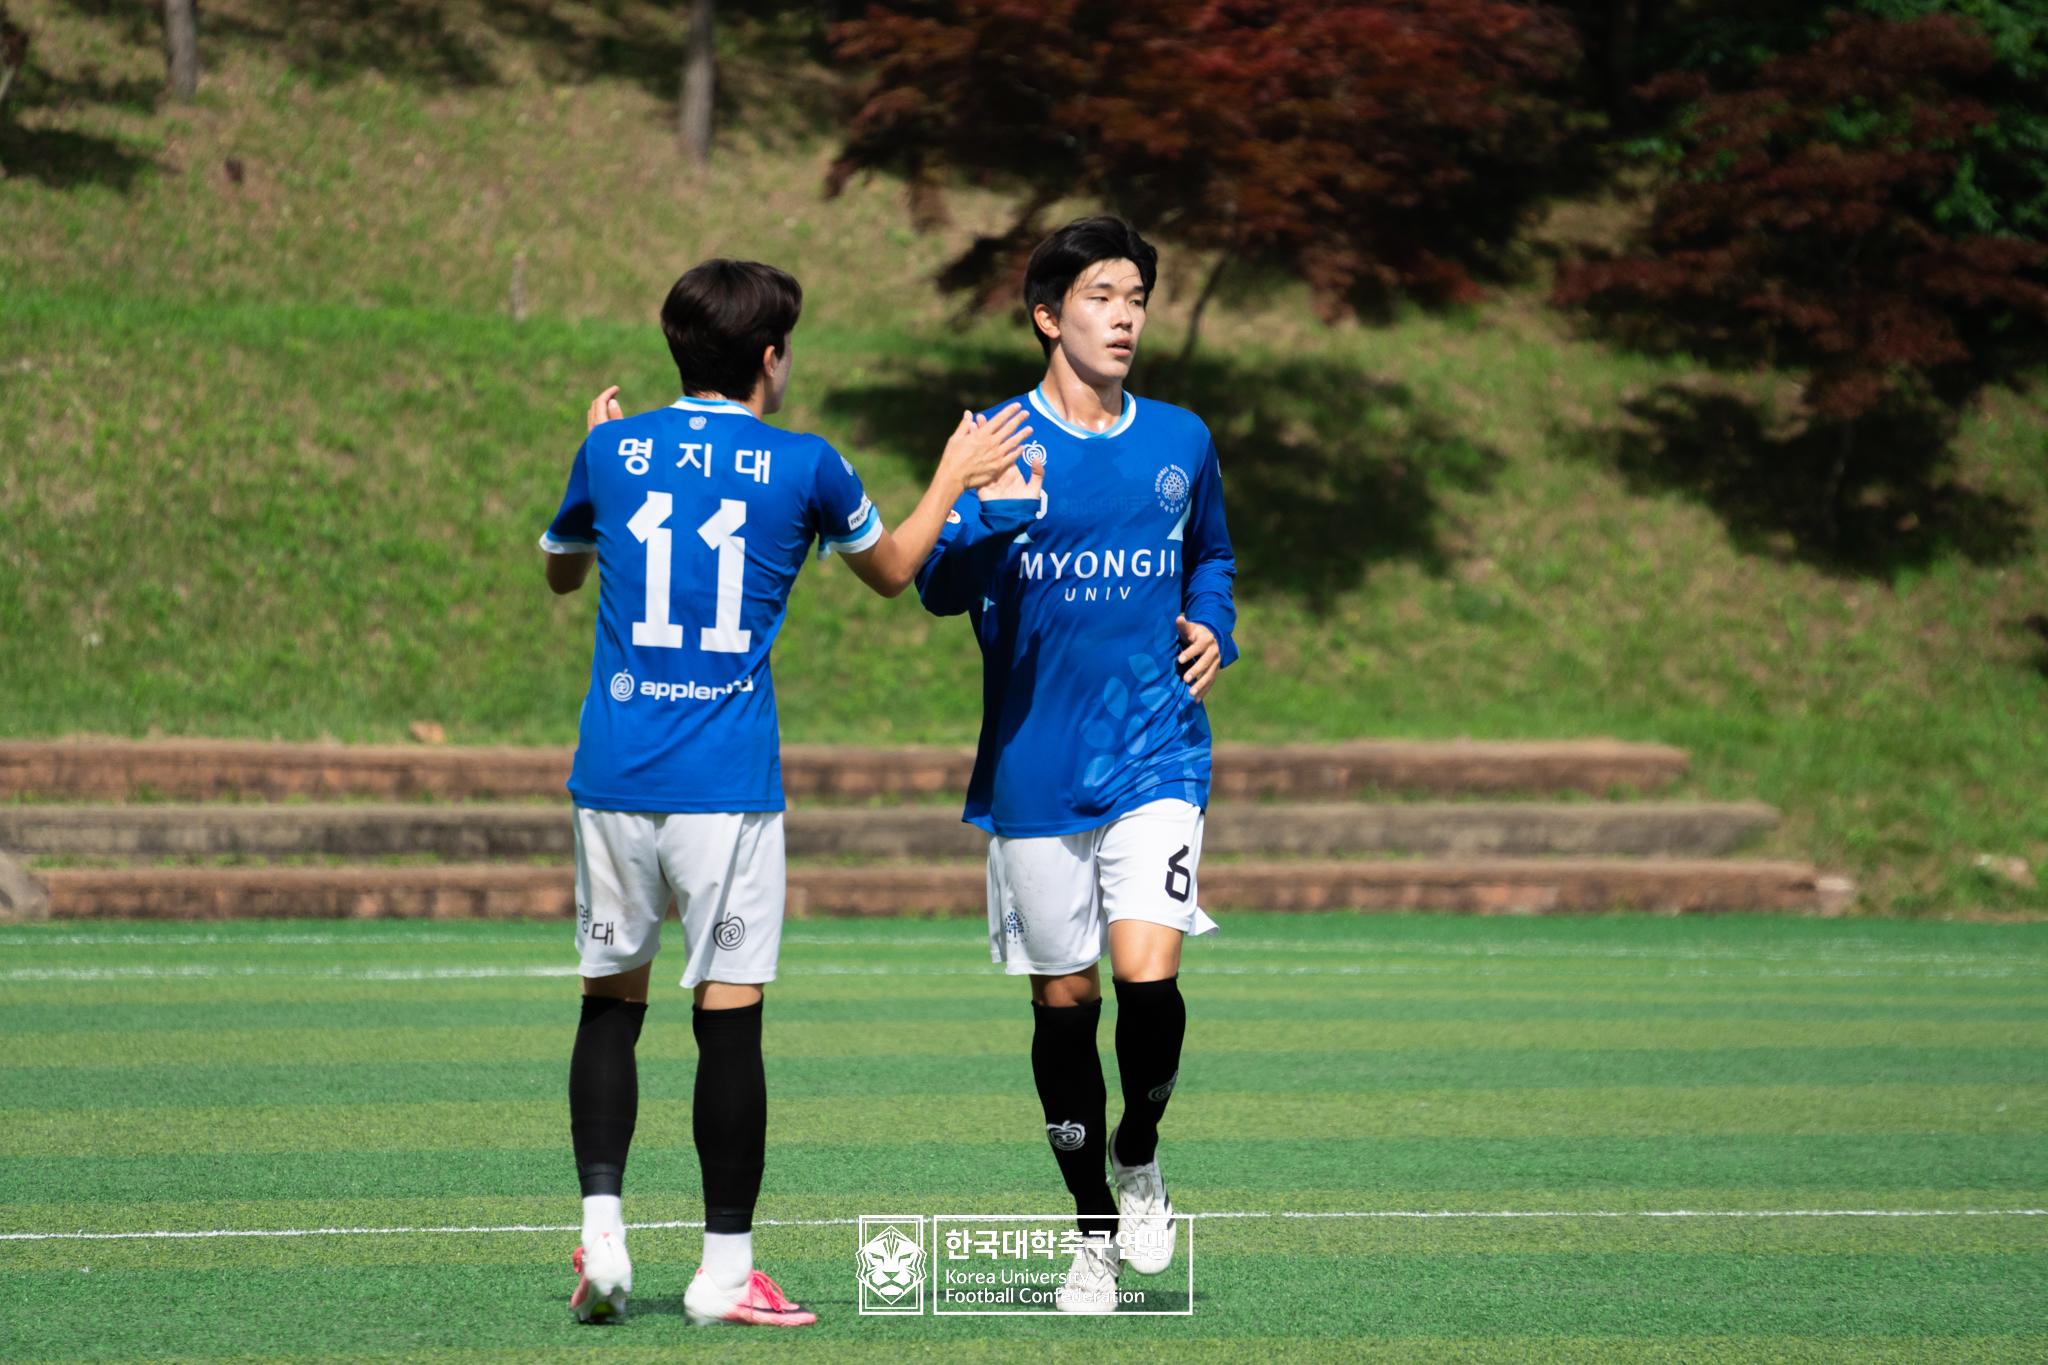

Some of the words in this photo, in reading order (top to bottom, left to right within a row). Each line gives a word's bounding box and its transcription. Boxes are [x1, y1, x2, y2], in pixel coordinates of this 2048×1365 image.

[626, 490, 752, 654] 11
[1018, 548, 1175, 580] MYONGJI
[1064, 585, 1132, 602] UNIV
[1164, 844, 1191, 903] 6
